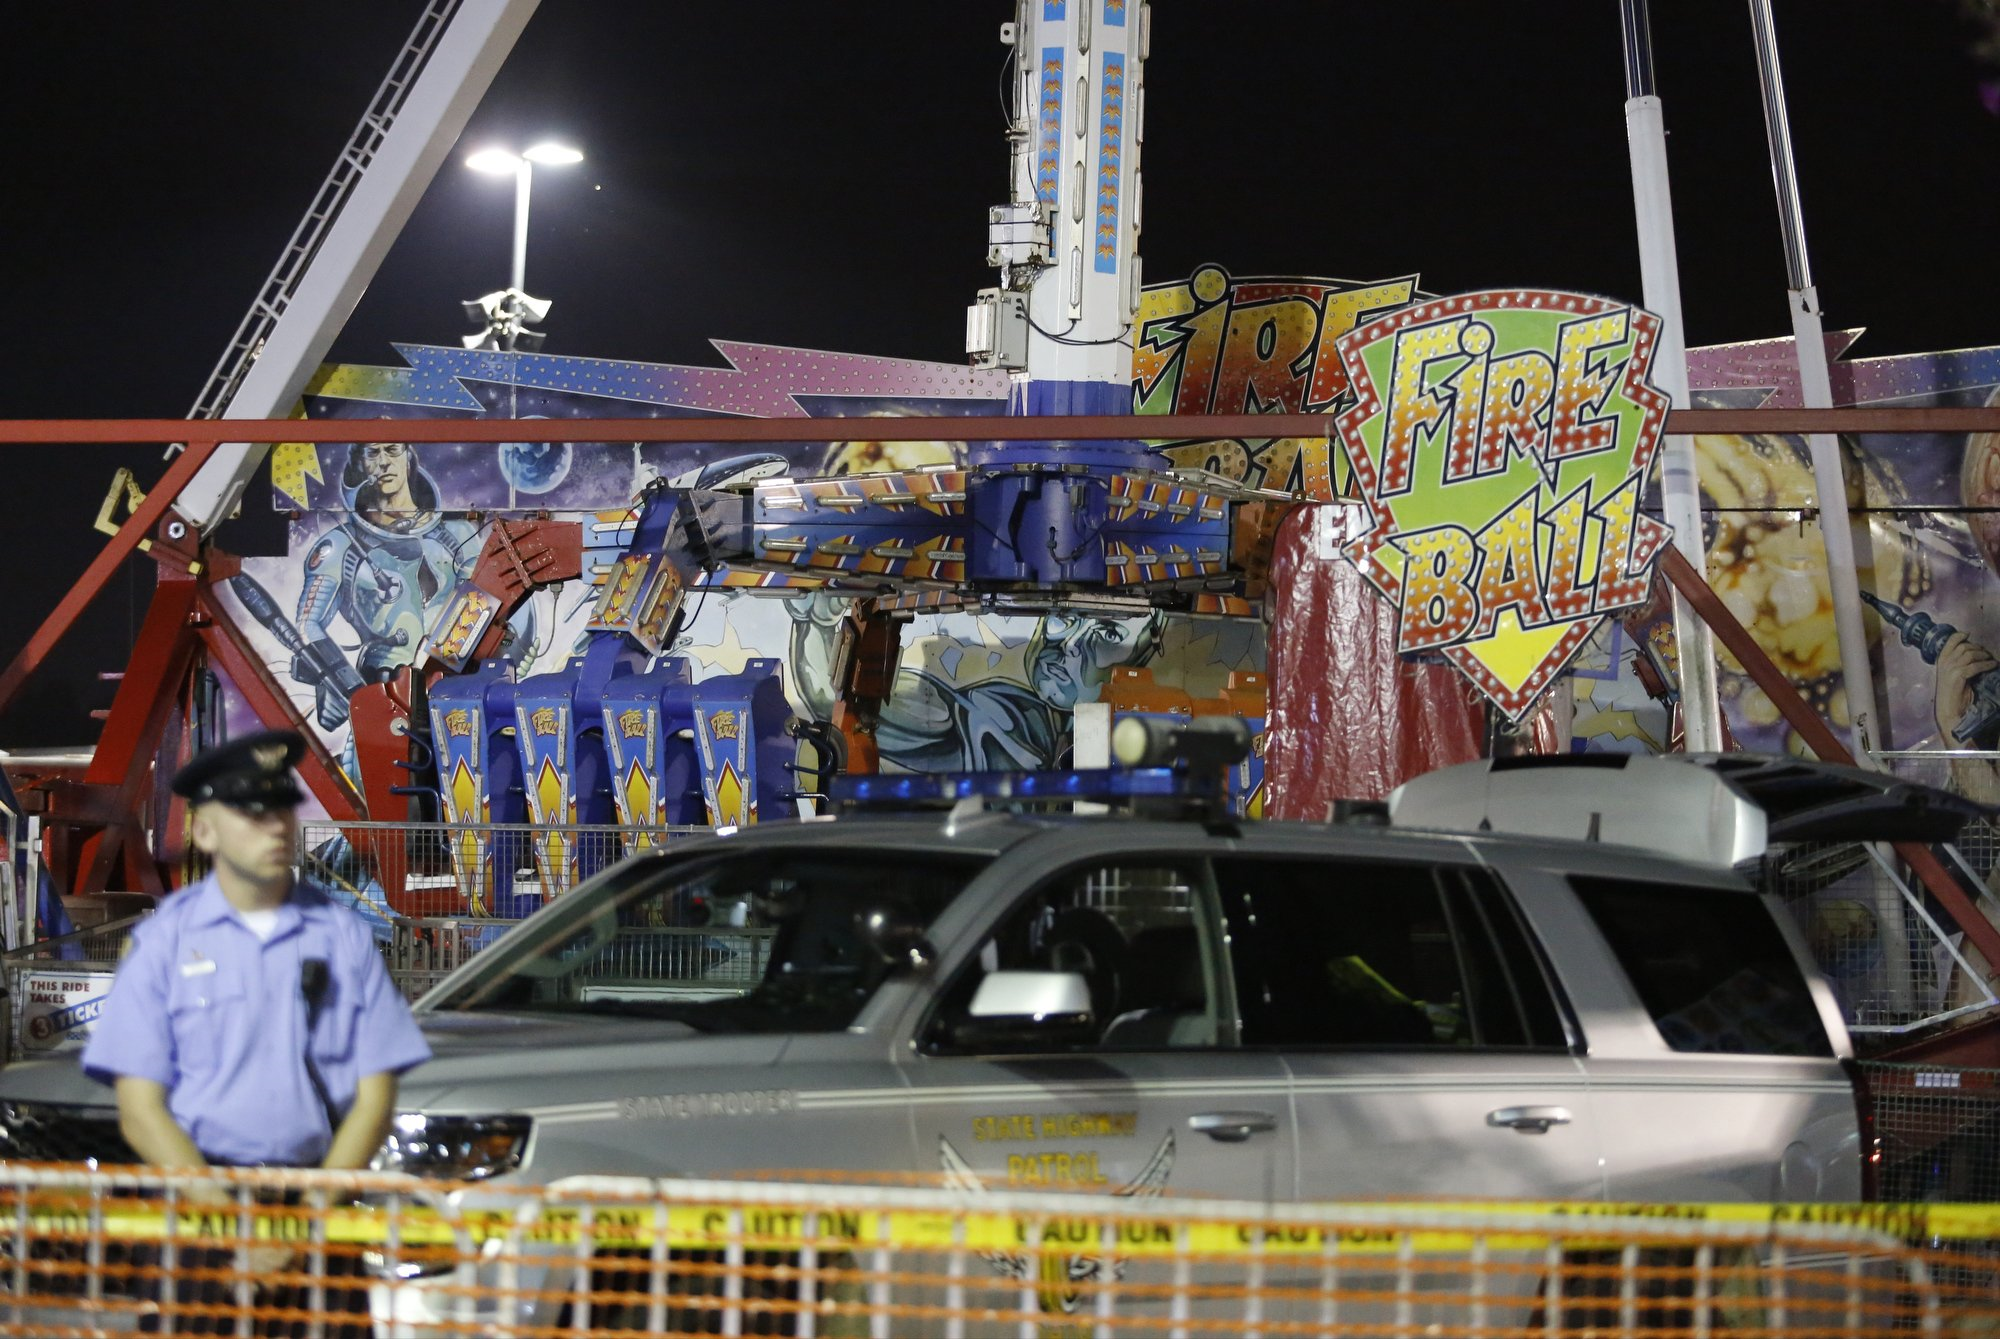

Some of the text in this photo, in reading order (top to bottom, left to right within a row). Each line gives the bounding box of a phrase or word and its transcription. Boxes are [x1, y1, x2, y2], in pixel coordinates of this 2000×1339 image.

[1384, 473, 1652, 653] BALL
[30, 981, 90, 992] THIS RIDE
[30, 993, 66, 1004] TAKES
[973, 1114, 1035, 1141] STATE
[1008, 1152, 1107, 1185] PATROL
